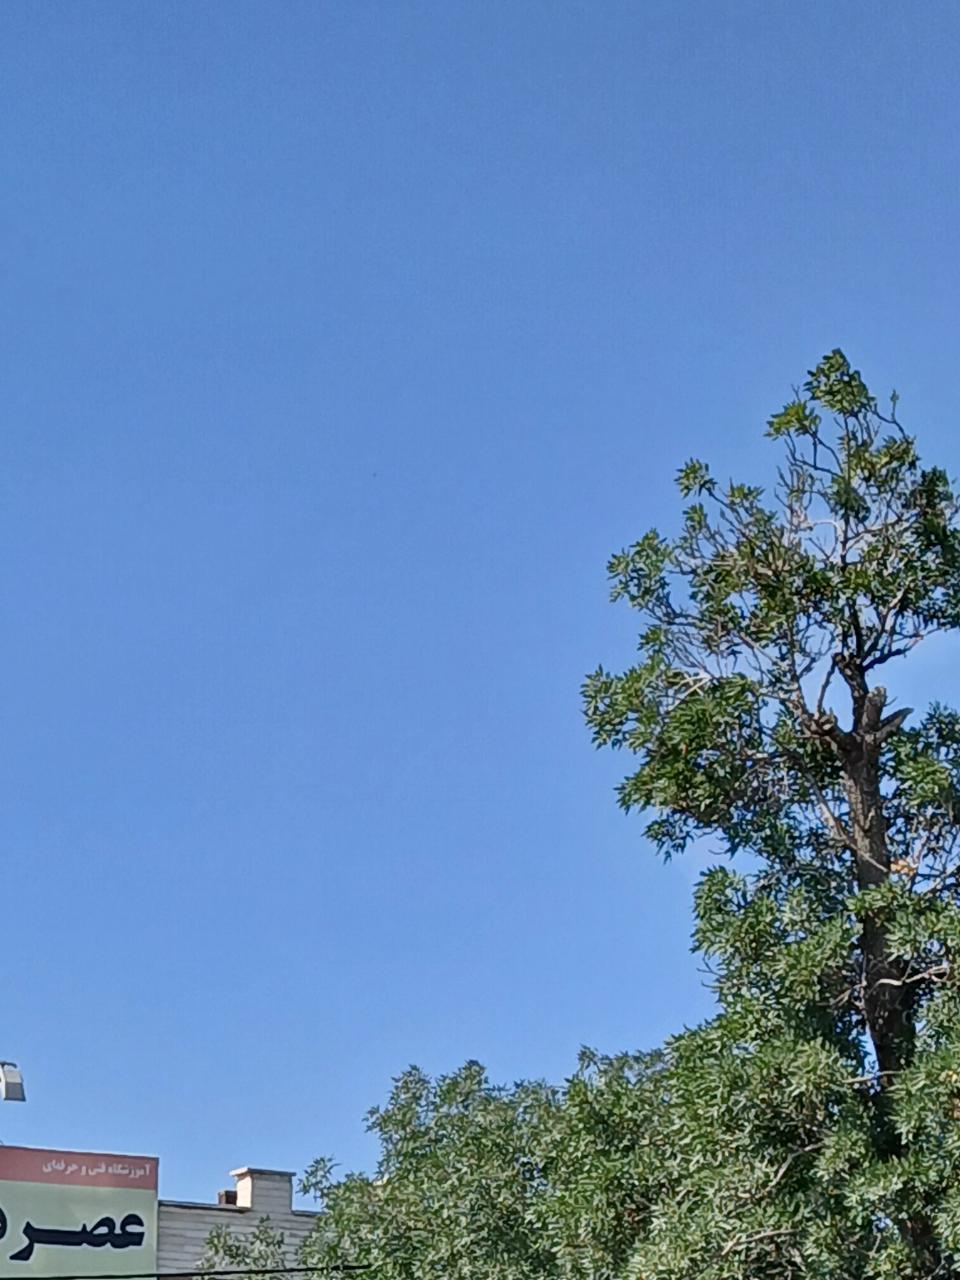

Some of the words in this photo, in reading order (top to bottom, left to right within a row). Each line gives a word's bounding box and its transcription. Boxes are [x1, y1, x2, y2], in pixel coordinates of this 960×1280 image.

[80, 1165, 87, 1176] و
[88, 1162, 106, 1176] فنی
[107, 1164, 151, 1178] آموزشگاه
[9, 1212, 146, 1262] عصر
